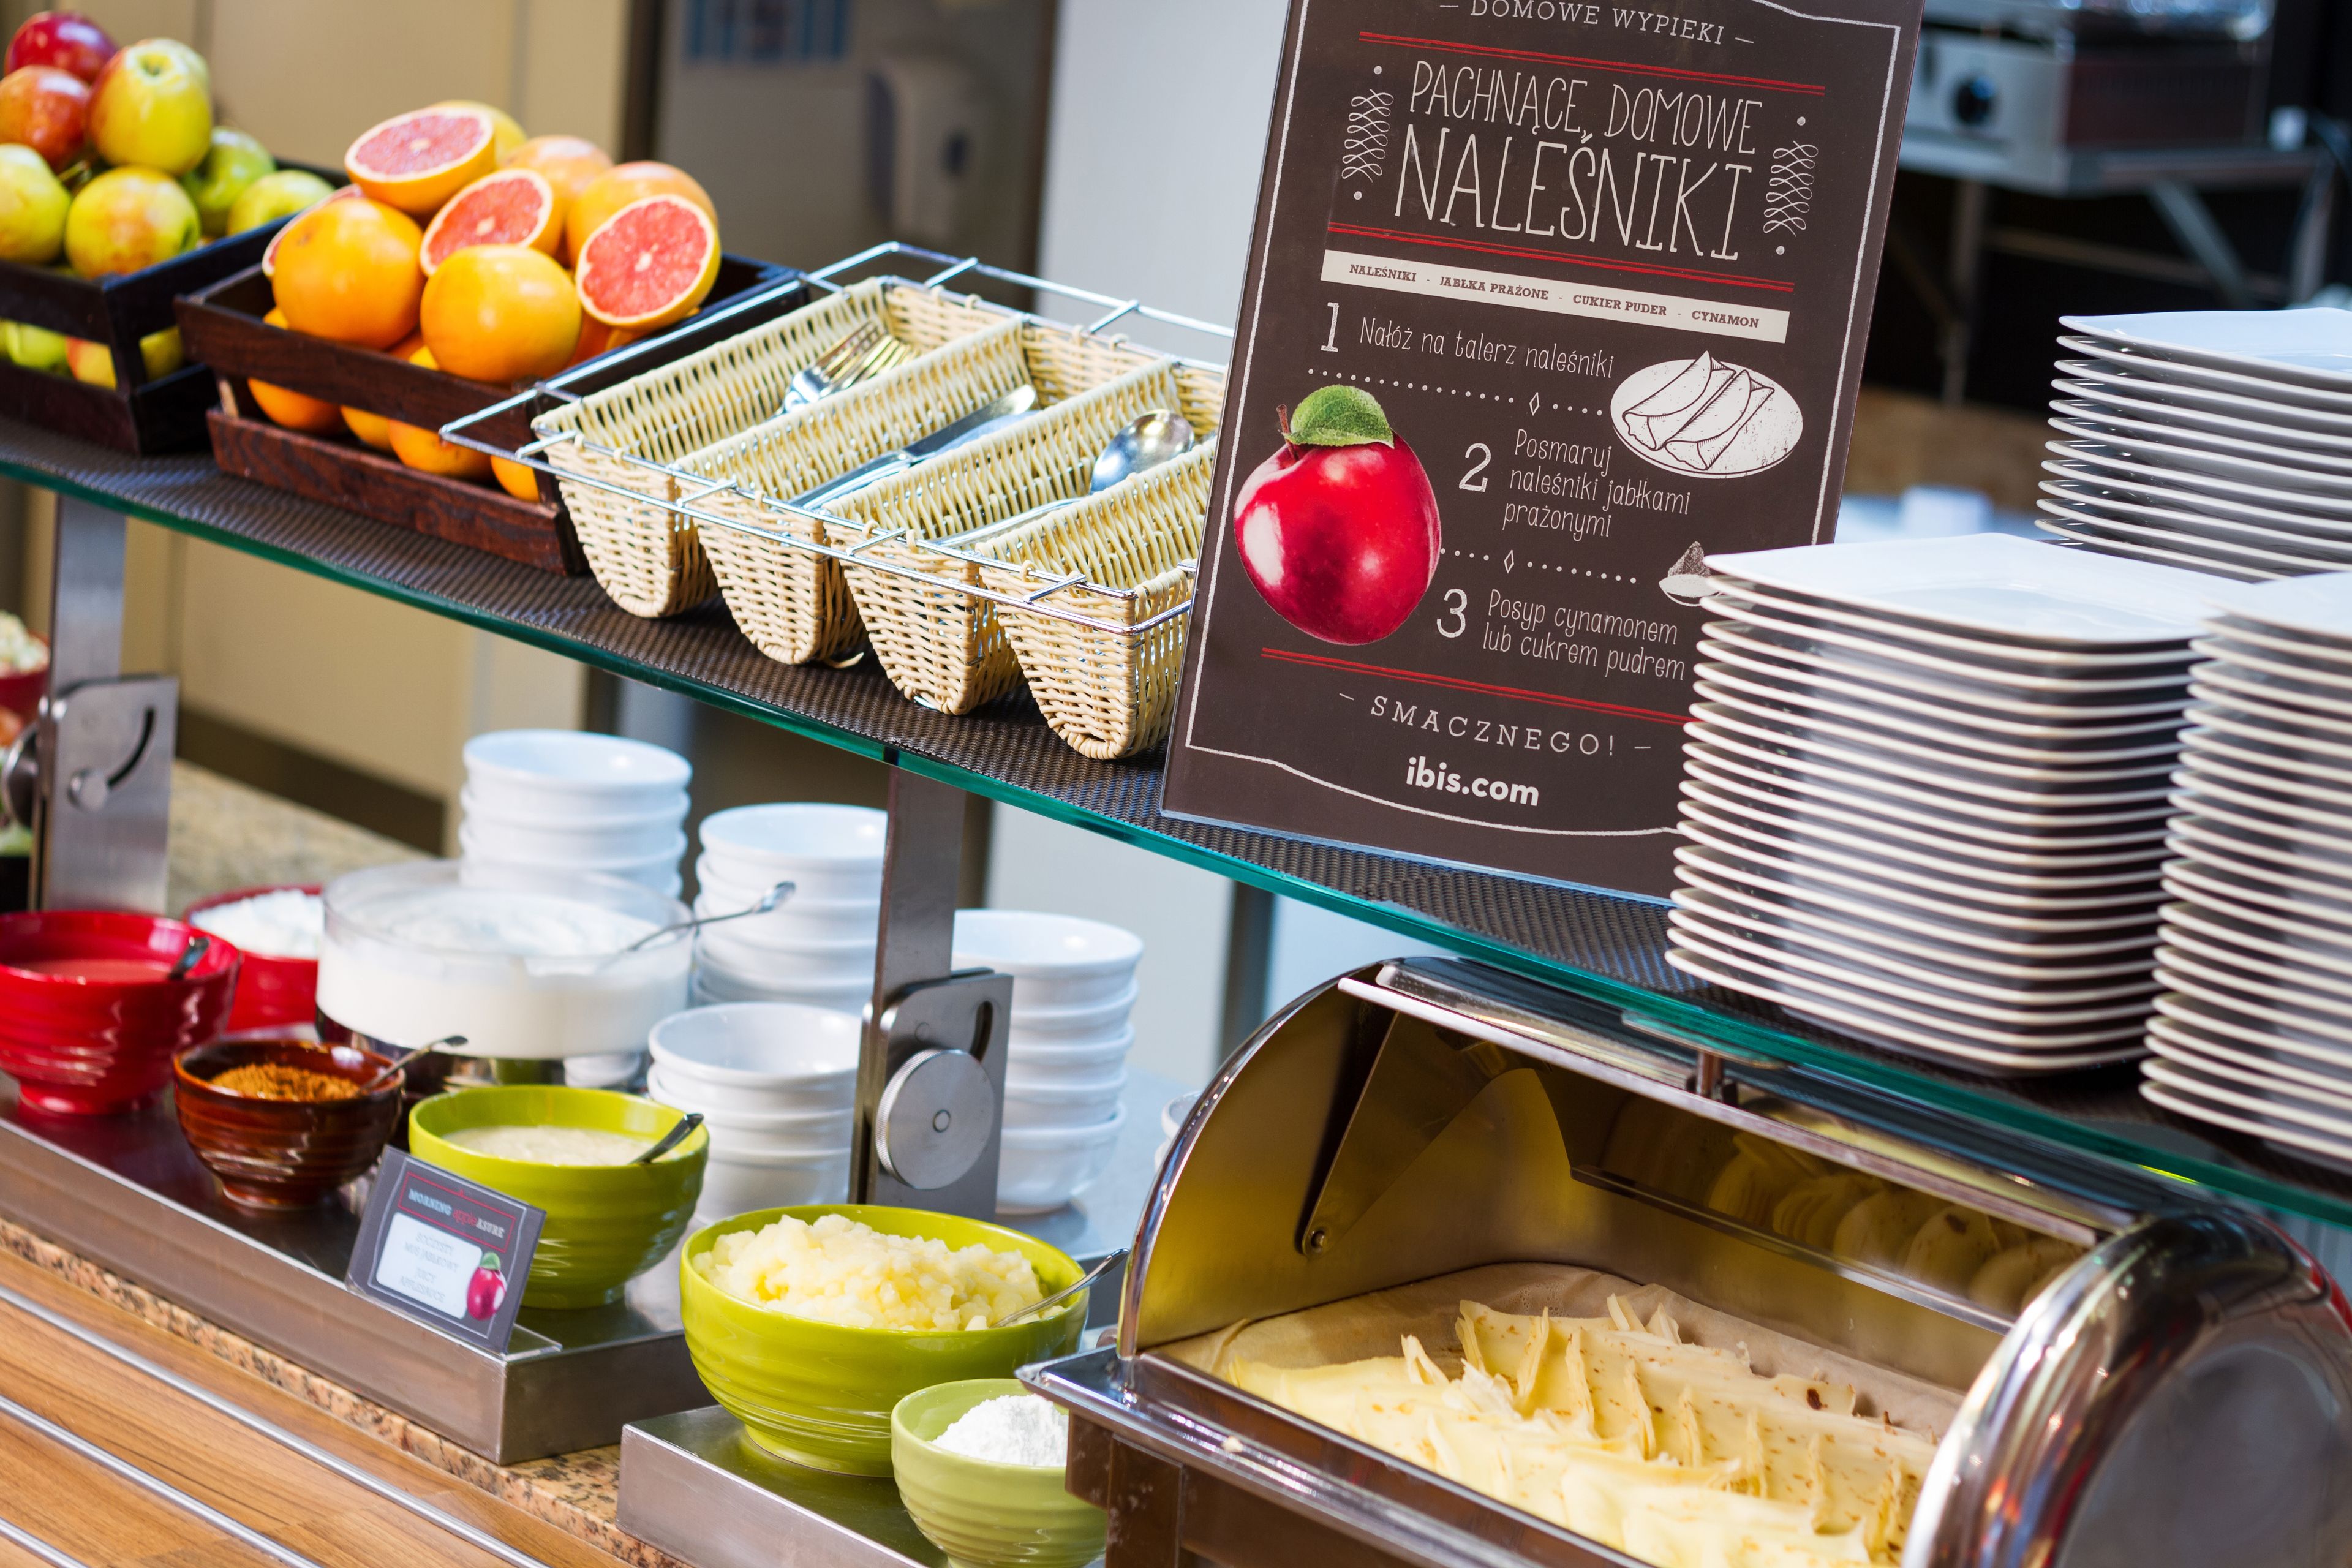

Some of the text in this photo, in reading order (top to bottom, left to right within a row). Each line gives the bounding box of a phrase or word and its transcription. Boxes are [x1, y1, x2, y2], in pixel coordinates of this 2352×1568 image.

[1471, 0, 1725, 45] DOMOWE WYPIEKI
[1604, 83, 1763, 156] DOMOWE
[1394, 124, 1753, 262] NALEŚNIKI
[1349, 263, 1760, 328] NALEŚNIKI JABŁKA PRAŻONE CUKIER PUDER CYNAMON
[1321, 302, 1615, 379] 1 Nałóż na talerz naleśniki
[1458, 442, 1491, 493] 2
[1515, 428, 1613, 477] Posmaruj
[1509, 465, 1691, 515] naleśniki jabłkami
[1501, 502, 1612, 542] prażonymi
[1436, 588, 1678, 646] 3 Posyp cynamonem
[1483, 622, 1686, 681] lub cukrem pudrem
[1370, 695, 1614, 756] SMACZNEGO!
[1406, 756, 1539, 807] ibis.com
